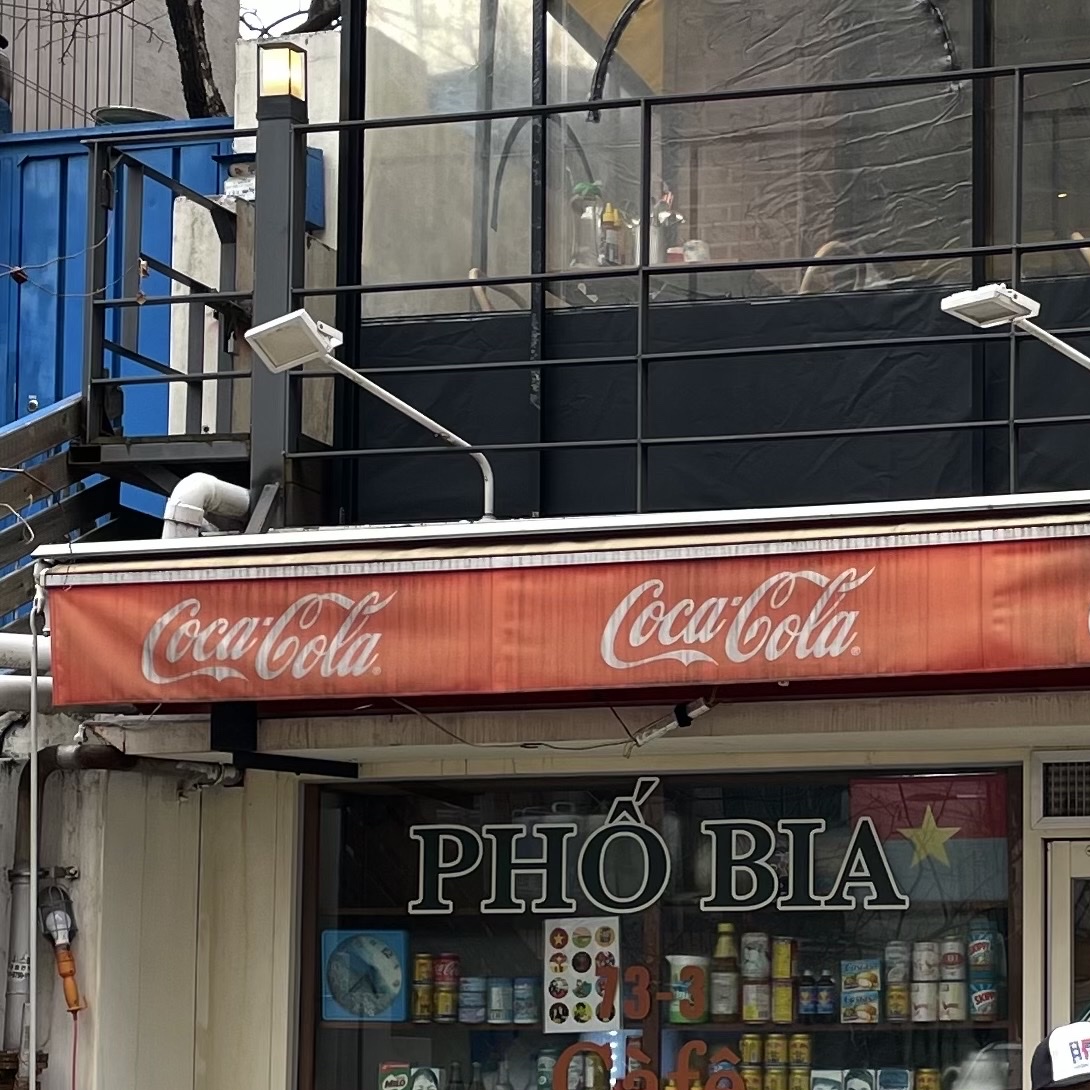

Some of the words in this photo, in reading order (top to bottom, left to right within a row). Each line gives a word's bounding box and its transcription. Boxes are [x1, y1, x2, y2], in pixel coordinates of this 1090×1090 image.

[142, 590, 397, 685] Coca-Cola
[600, 564, 875, 669] Coca-Cola
[408, 777, 671, 914] PHỐ
[700, 816, 909, 912] BIA
